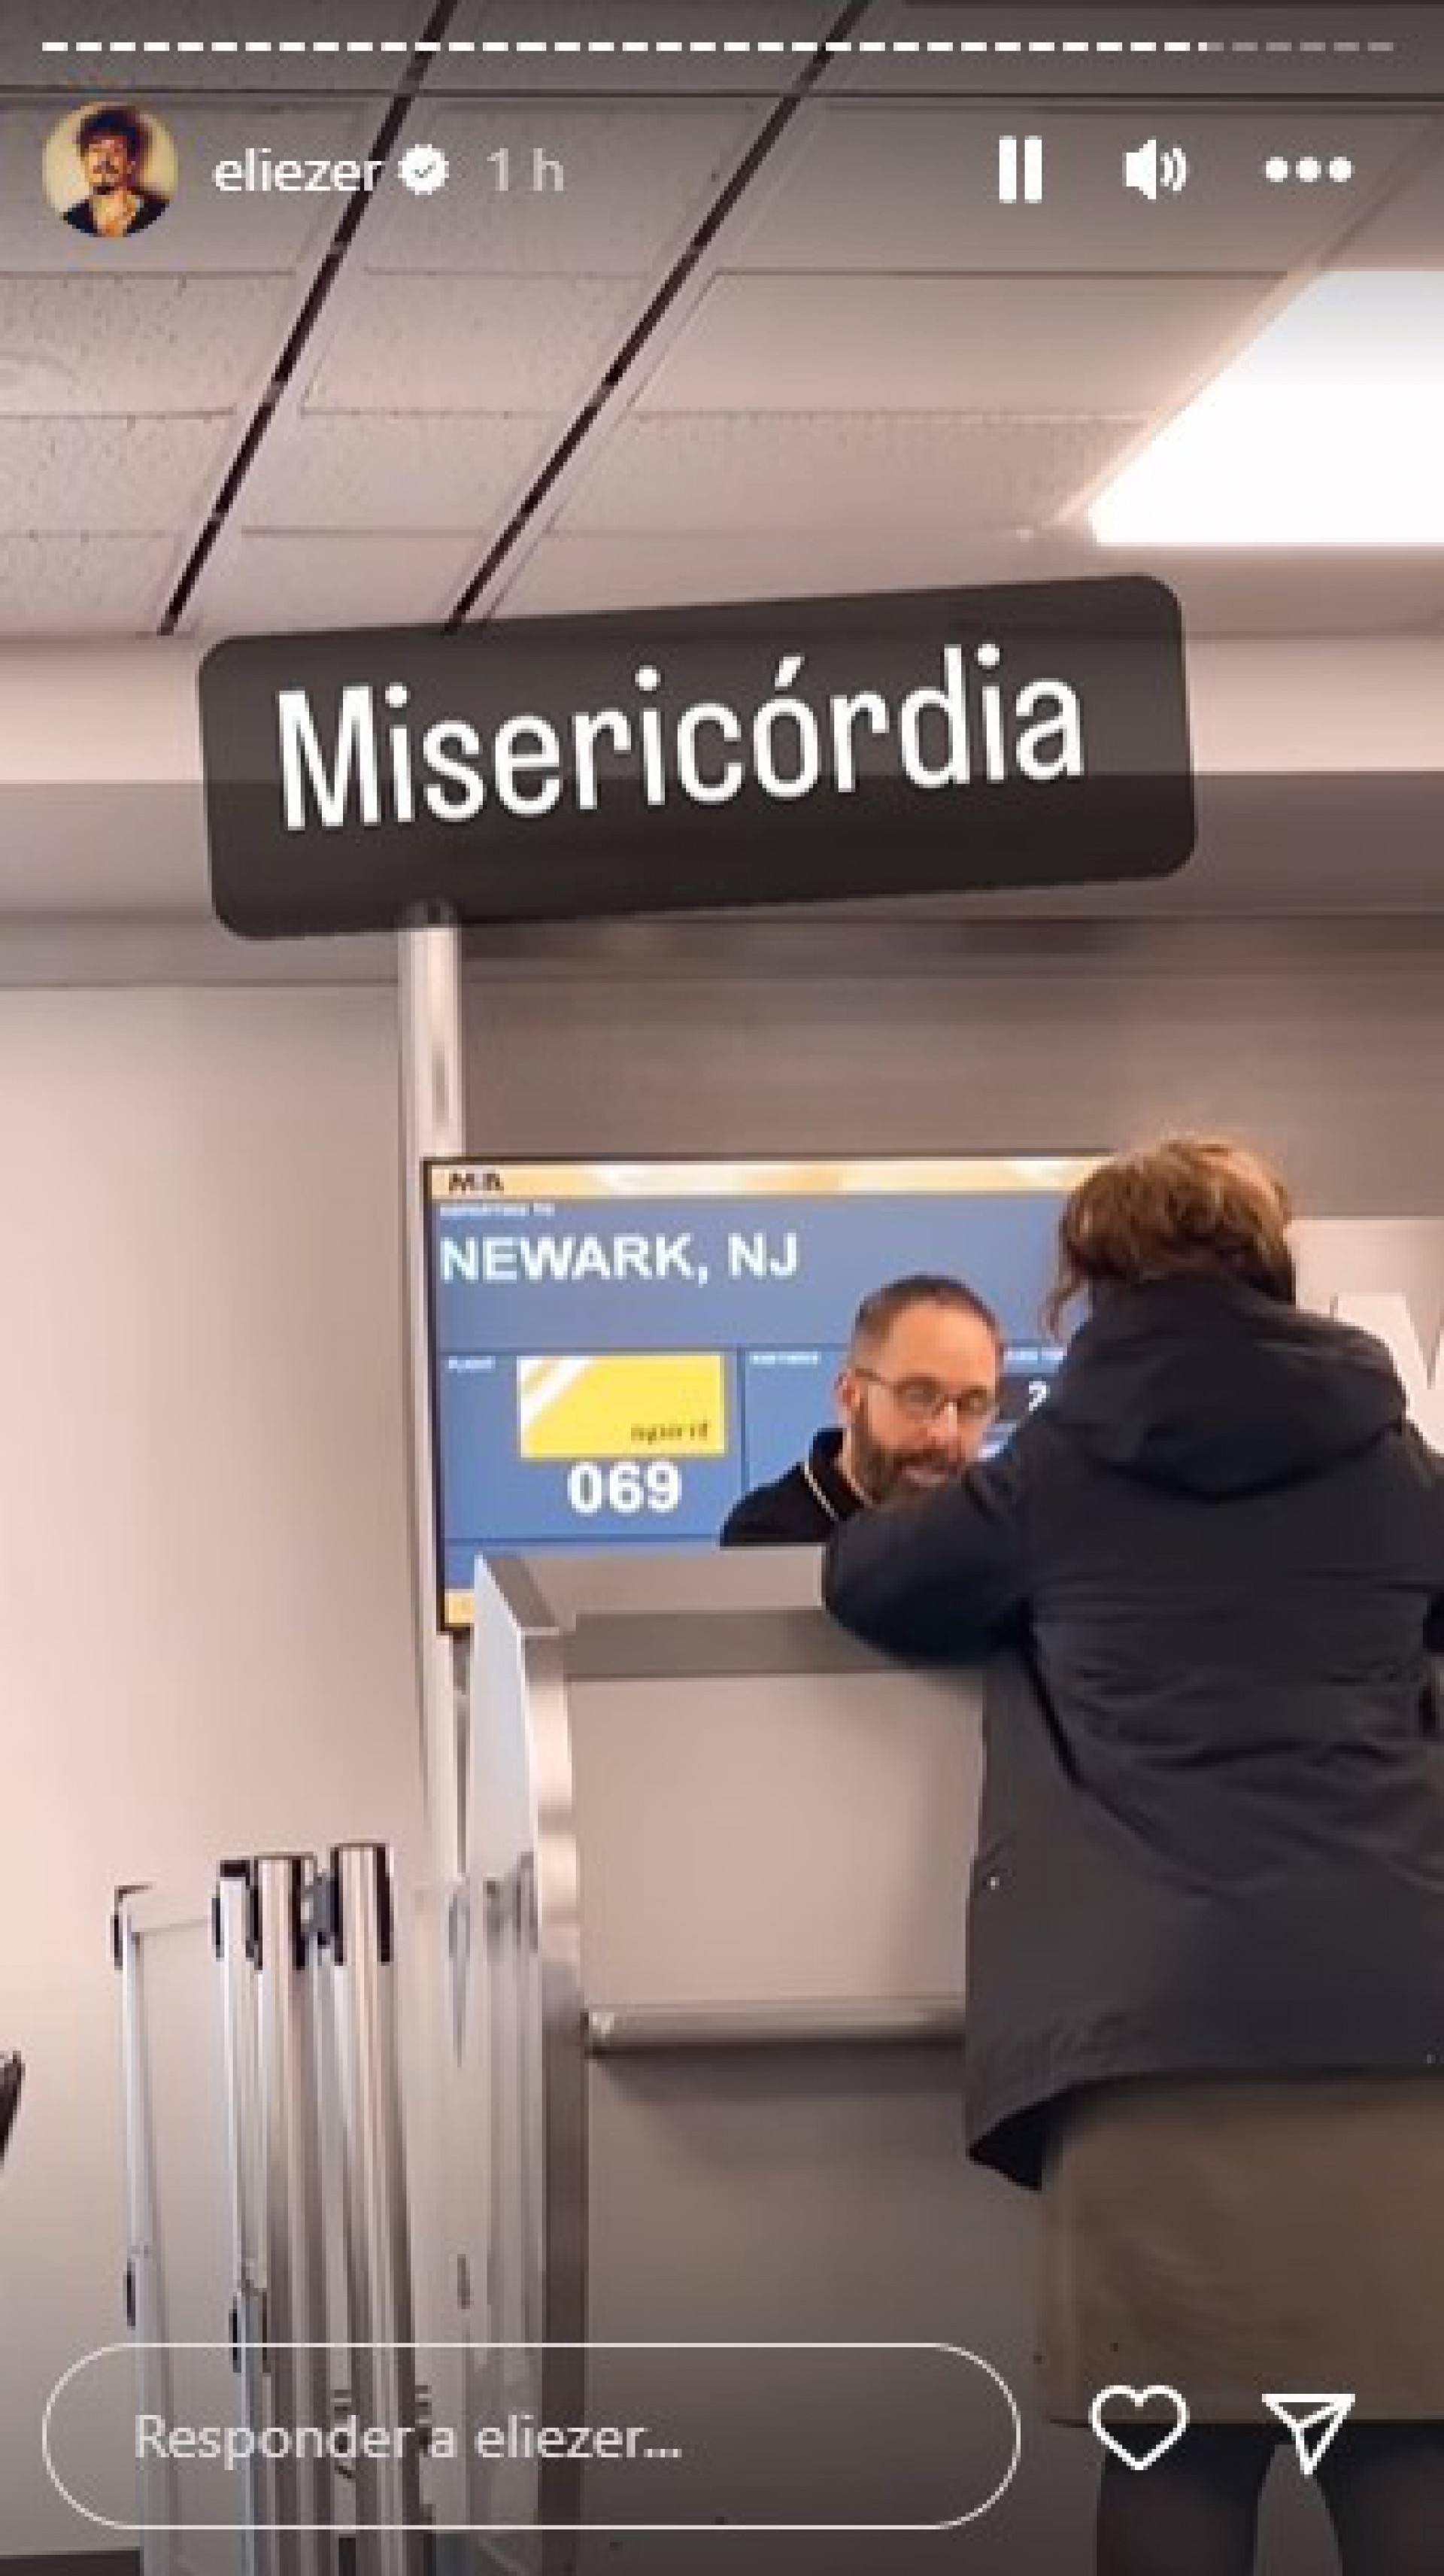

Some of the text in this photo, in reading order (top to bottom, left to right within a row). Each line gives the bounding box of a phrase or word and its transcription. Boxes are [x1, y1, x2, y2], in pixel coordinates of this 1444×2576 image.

[440, 1232, 798, 1286] NEWARK, NJ
[568, 1461, 681, 1514] 069
